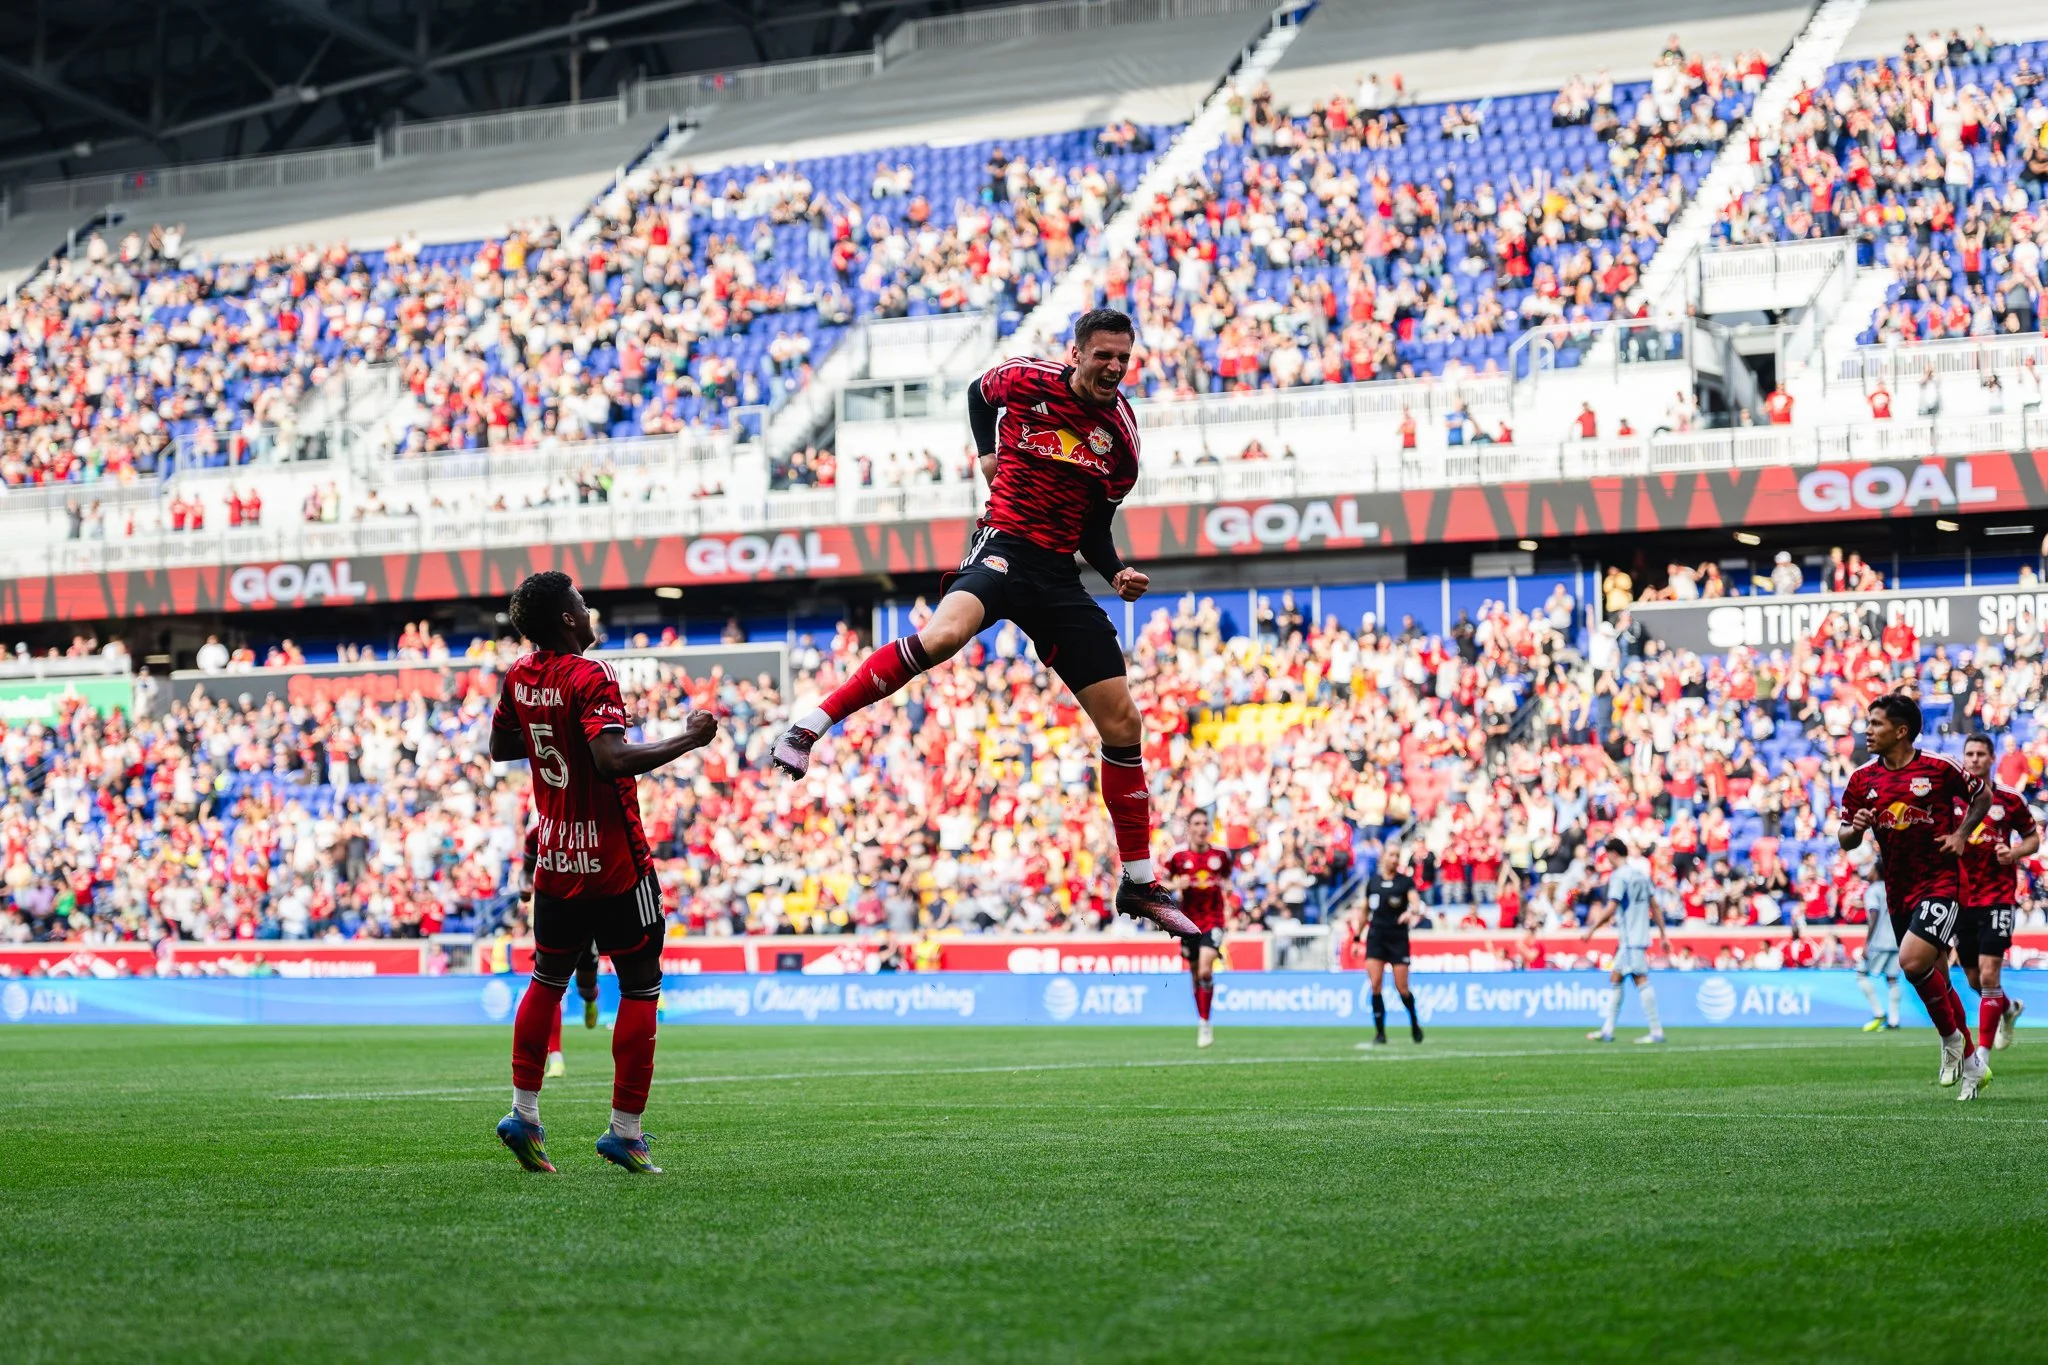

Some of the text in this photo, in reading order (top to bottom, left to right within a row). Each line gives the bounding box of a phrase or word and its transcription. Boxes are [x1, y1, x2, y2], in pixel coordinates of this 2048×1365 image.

[1798, 463, 1997, 513] GOAL
[1204, 500, 1379, 548] GOAL
[685, 533, 840, 577] GOAL
[230, 561, 366, 603] GOAL
[515, 681, 564, 706] VALENCIA
[529, 723, 569, 790] 5
[536, 849, 602, 874] ed Bulls
[1919, 900, 1948, 925] 19
[1990, 909, 2011, 930] 15
[1060, 955, 1183, 973] STADIUM
[30, 990, 78, 1014] AT&T
[845, 983, 976, 1017] Everything
[1081, 984, 1148, 1014] AT&T
[1211, 983, 1354, 1017] Connecting
[1465, 980, 1618, 1019] Everything
[1740, 984, 1813, 1016] AT&T
